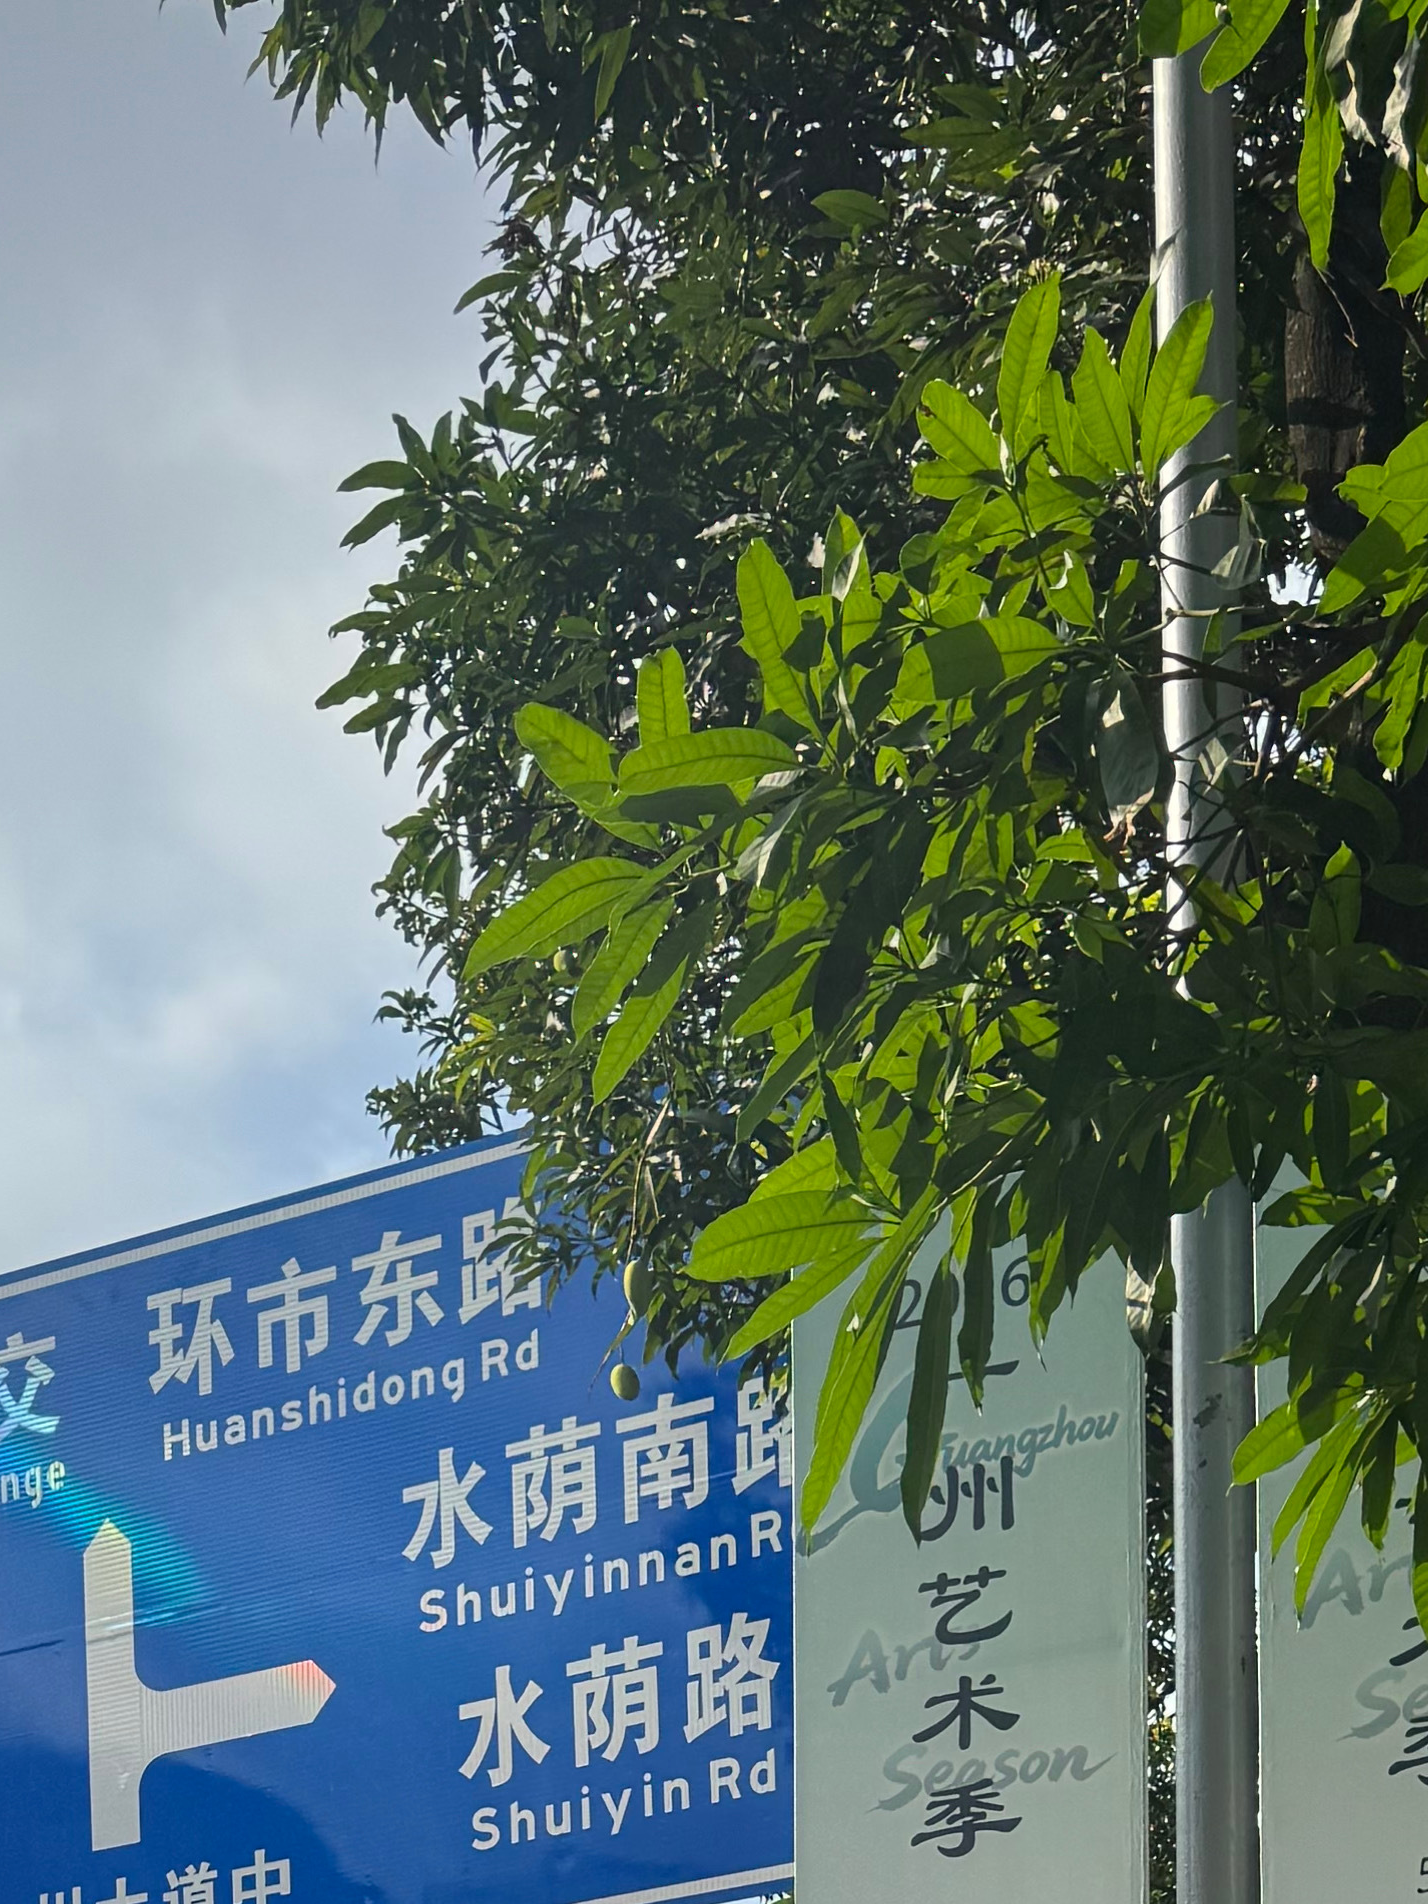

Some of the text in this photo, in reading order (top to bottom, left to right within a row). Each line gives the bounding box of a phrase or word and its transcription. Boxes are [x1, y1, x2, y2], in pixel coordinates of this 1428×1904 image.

[147, 1197, 544, 1396] 环市东路
[163, 1329, 539, 1461] Huanshidong Rd
[419, 1533, 737, 1633] Shuiyinnan
[912, 1360, 1024, 1858] 州艺术季
[458, 1612, 781, 1788] 水荫路
[472, 1748, 776, 1851] Shuiyin Rd
[864, 1744, 1118, 1813] Season
